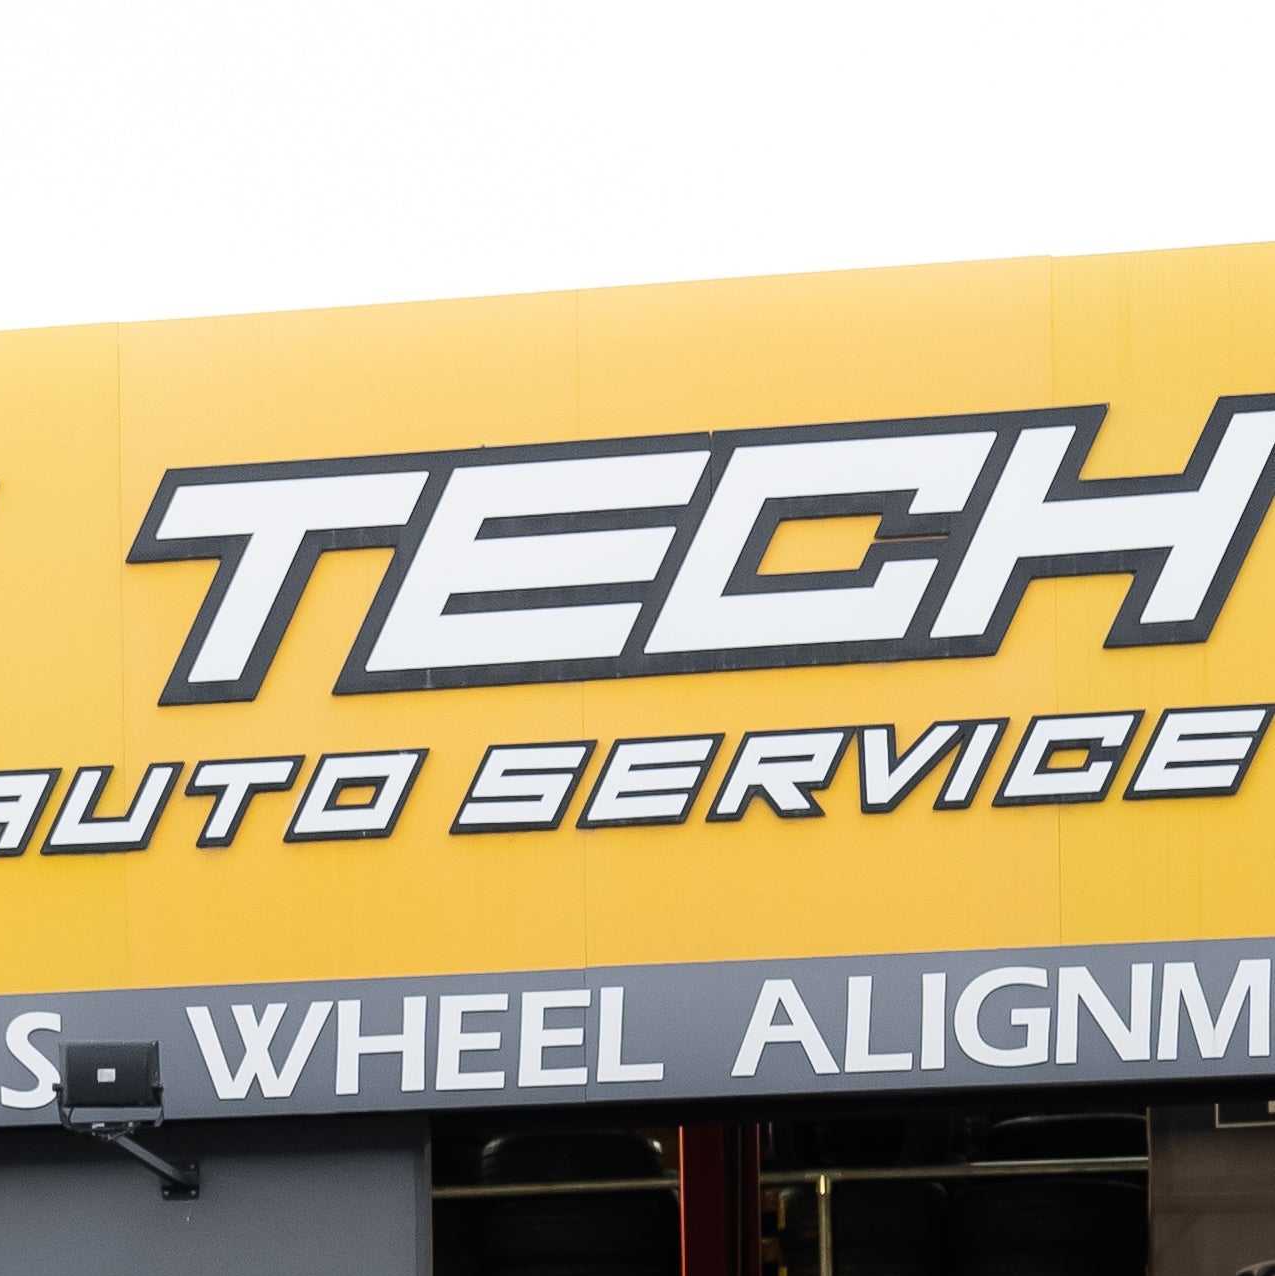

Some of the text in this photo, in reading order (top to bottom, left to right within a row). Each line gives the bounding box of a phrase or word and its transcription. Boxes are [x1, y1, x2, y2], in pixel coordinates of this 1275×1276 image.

[126, 393, 1275, 707] TECH
[449, 703, 1275, 836] SERVICE
[186, 987, 664, 1099] WHEEL
[731, 958, 1271, 1077] ALIGNM
